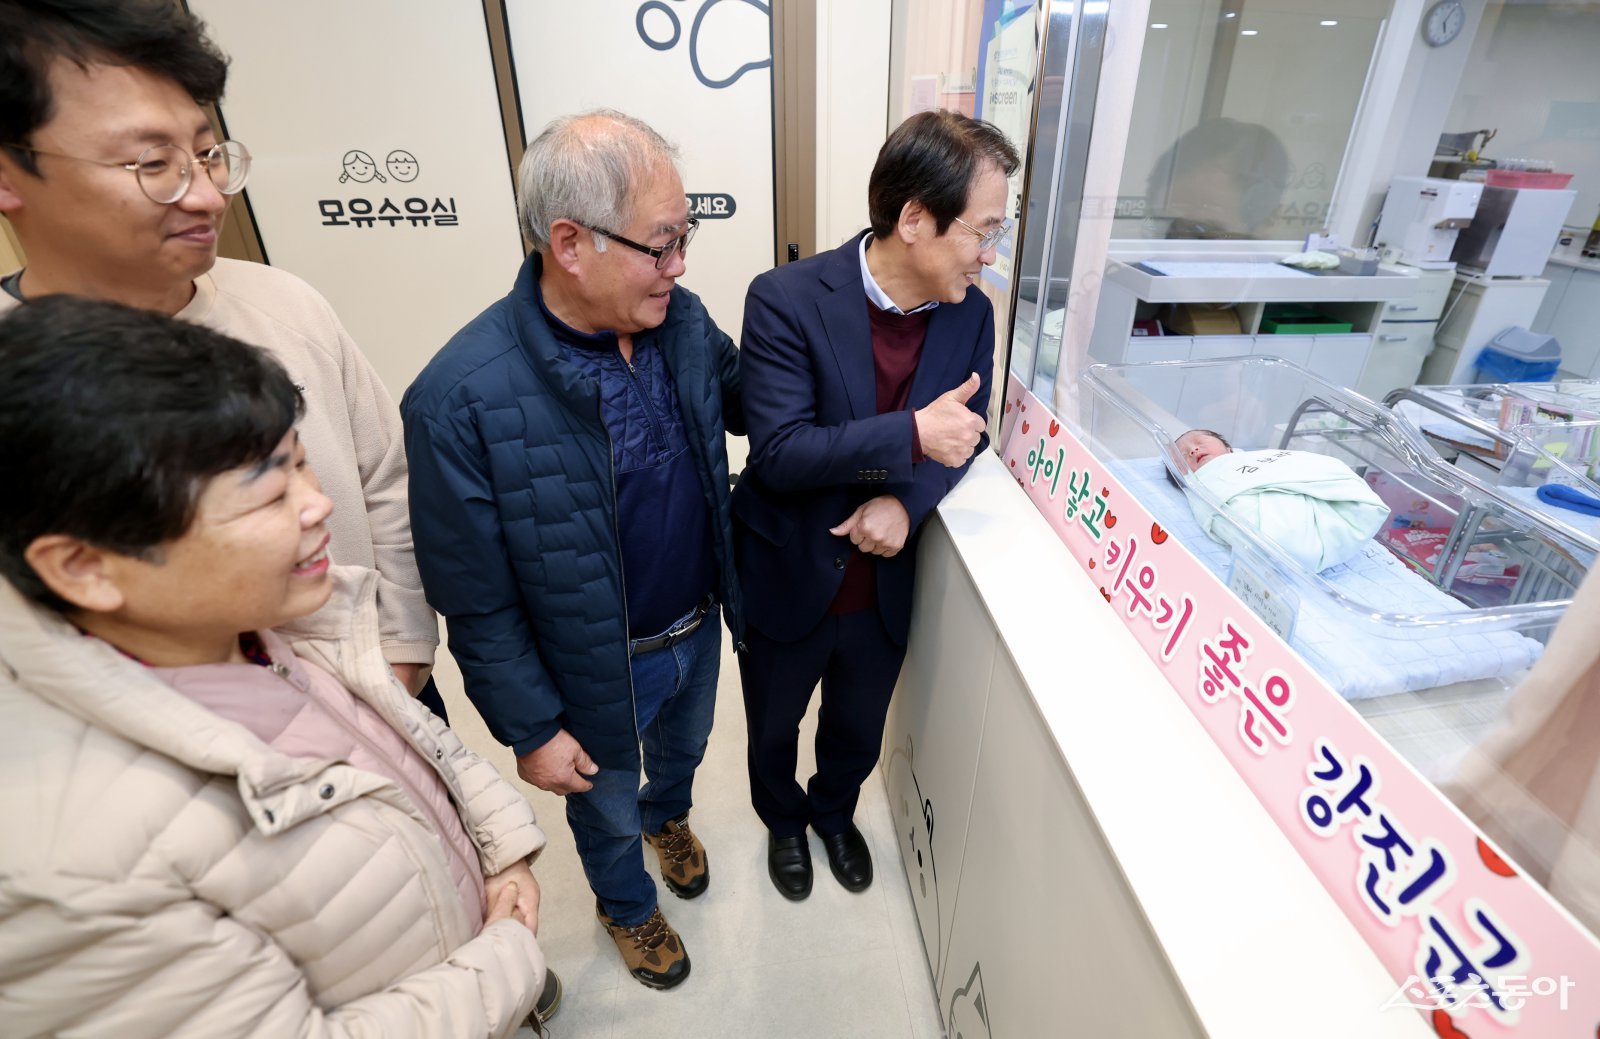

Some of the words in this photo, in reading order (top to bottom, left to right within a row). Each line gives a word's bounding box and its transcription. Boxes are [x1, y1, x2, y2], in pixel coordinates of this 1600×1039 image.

[318, 197, 459, 227] 모유수유실
[1027, 438, 1064, 495] 아이
[1067, 471, 1105, 539] 낳고
[1106, 538, 1193, 656] 키우기
[1203, 623, 1290, 747] 좋은
[1306, 745, 1518, 1012] 강진군
